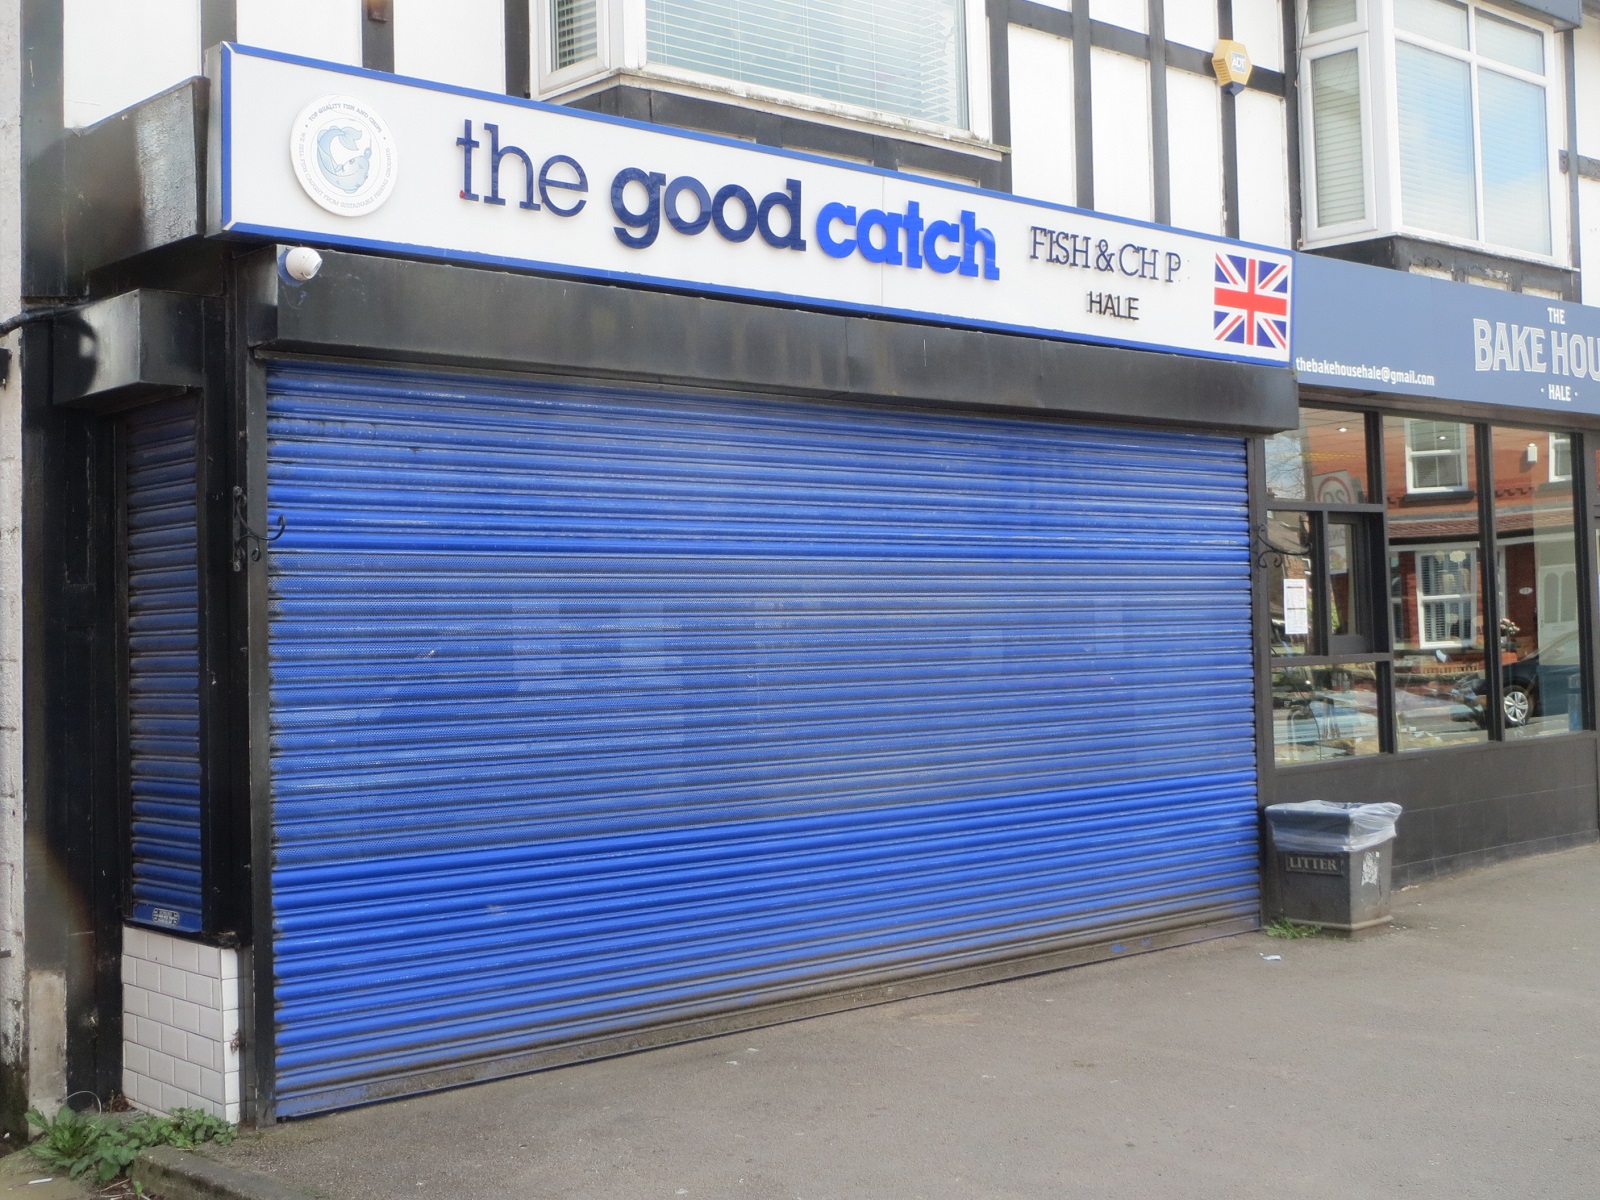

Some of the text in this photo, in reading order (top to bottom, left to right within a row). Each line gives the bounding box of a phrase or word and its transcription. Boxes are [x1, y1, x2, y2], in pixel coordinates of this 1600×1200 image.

[456, 118, 1000, 281] the good catch
[1088, 291, 1140, 321] HALE
[1547, 307, 1566, 325] THE
[1473, 318, 1547, 373] BAKE
[1295, 357, 1435, 386] thebakehousehale@gmail.com
[1548, 383, 1571, 402] HALE
[1289, 856, 1337, 871] LITTER
